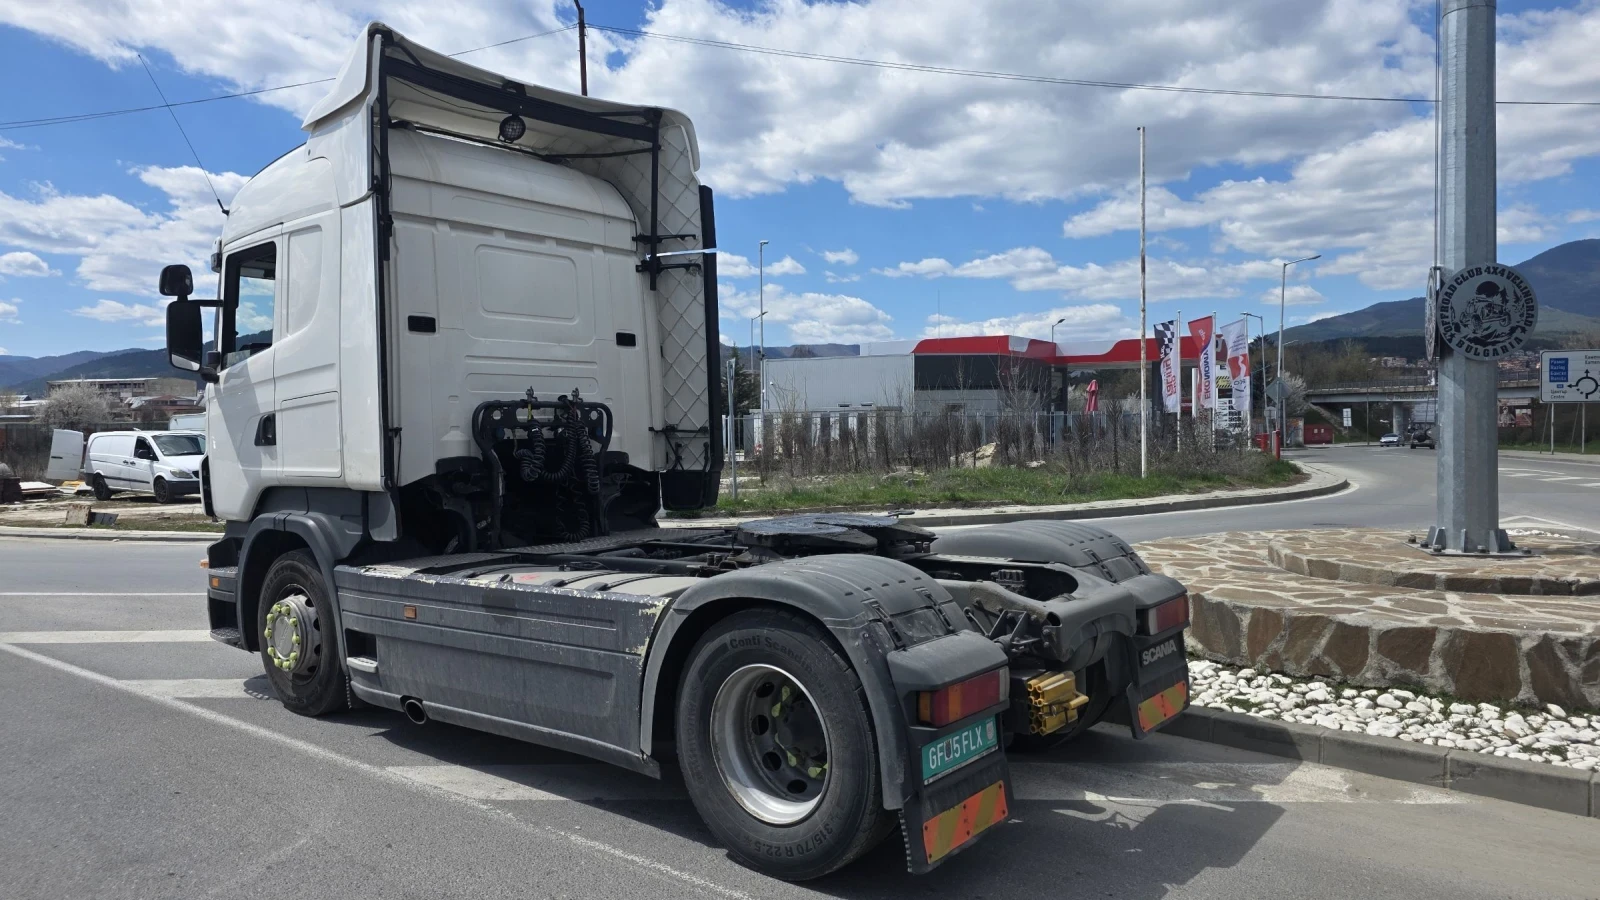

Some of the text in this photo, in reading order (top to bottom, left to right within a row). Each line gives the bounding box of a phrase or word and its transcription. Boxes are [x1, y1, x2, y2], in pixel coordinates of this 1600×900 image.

[1440, 265, 1534, 333] OFFROAD CLUB 4X4 VELINGRAD
[1456, 336, 1522, 357] BULGARIA
[730, 635, 760, 649] Conti
[1142, 639, 1177, 665] SCANIA
[754, 823, 834, 857] 315/70 R 22.5
